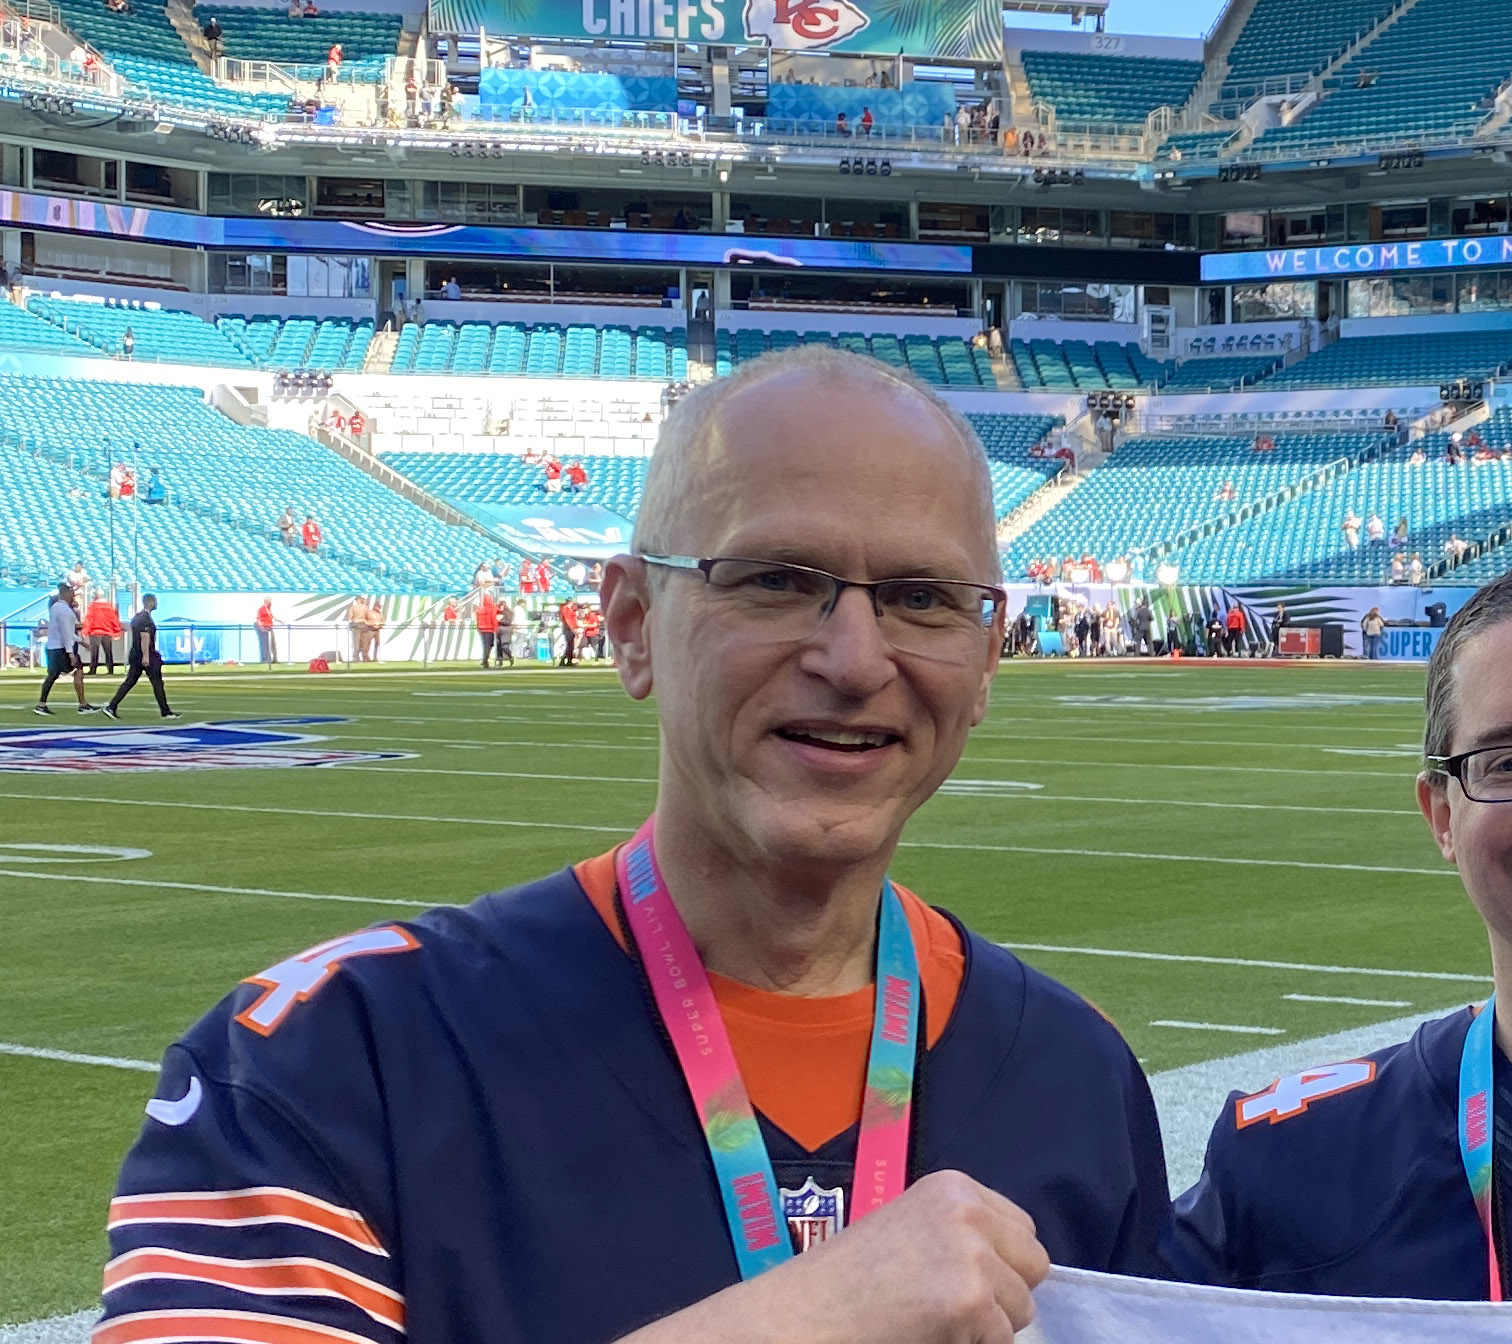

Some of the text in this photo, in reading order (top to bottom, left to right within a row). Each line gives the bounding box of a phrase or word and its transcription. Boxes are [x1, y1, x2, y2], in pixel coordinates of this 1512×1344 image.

[1094, 35, 1121, 51] 327
[1265, 239, 1422, 274] WELCOME
[1441, 238, 1482, 263] TO
[1378, 630, 1432, 657] SUPER
[235, 925, 422, 1037] 4
[662, 939, 688, 992] BOWL
[680, 998, 714, 1057] SUPER
[881, 974, 912, 1045] MIAMI
[1235, 1059, 1378, 1131] 4
